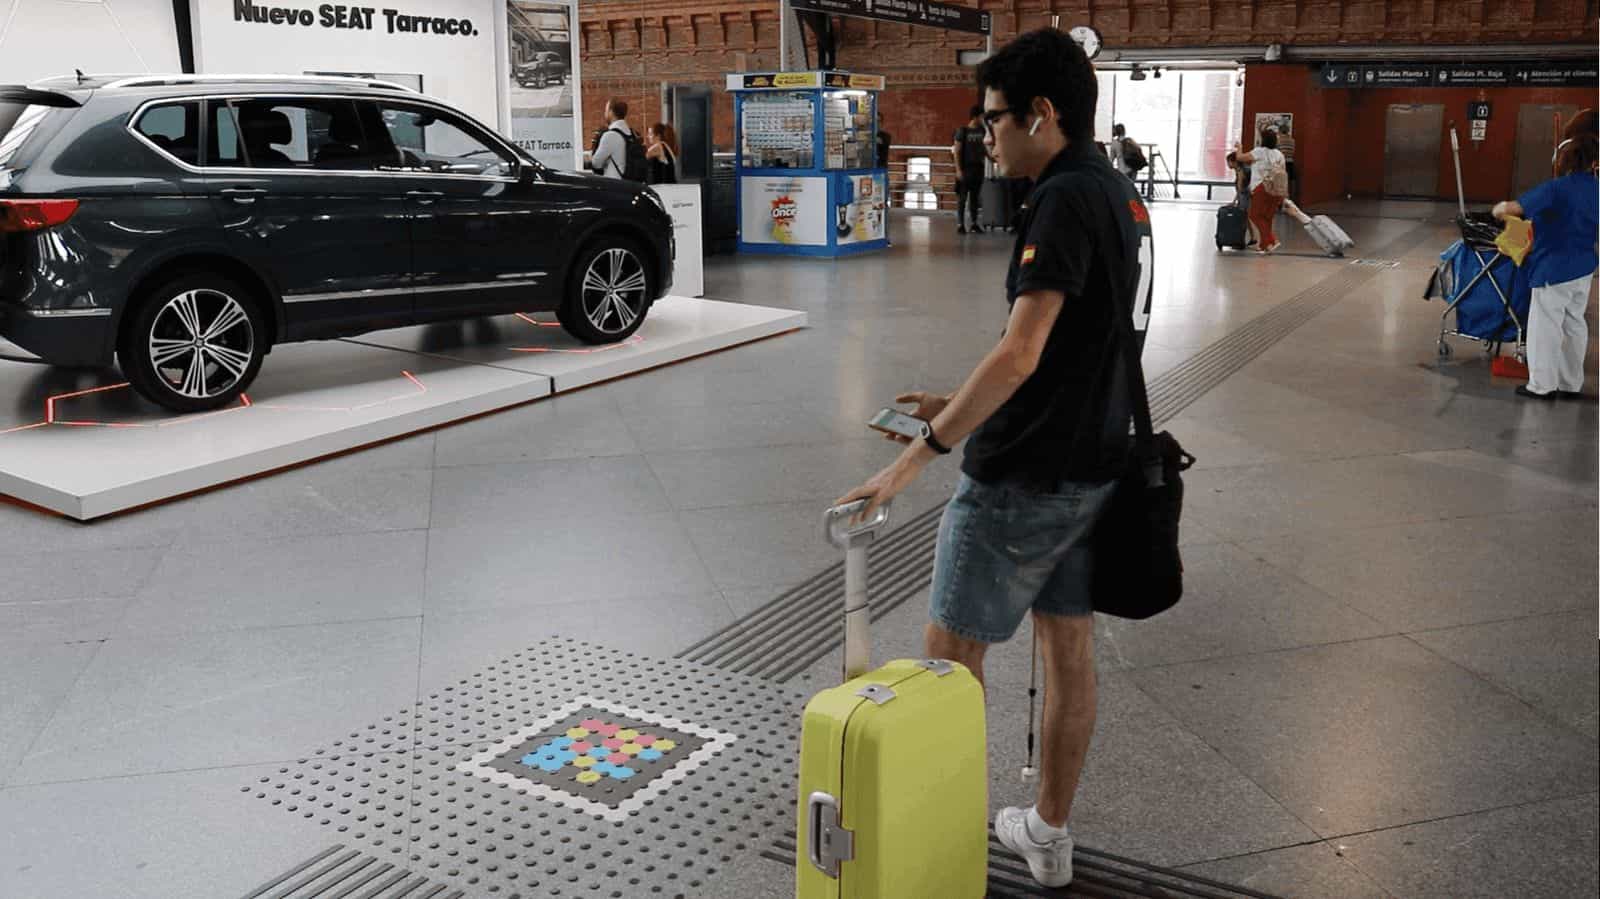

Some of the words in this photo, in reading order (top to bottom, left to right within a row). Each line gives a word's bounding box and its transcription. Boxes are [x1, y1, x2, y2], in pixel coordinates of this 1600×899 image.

[234, 0, 314, 26] Nuevo
[319, 4, 375, 30] SEAT
[383, 9, 478, 36] Tarraco.
